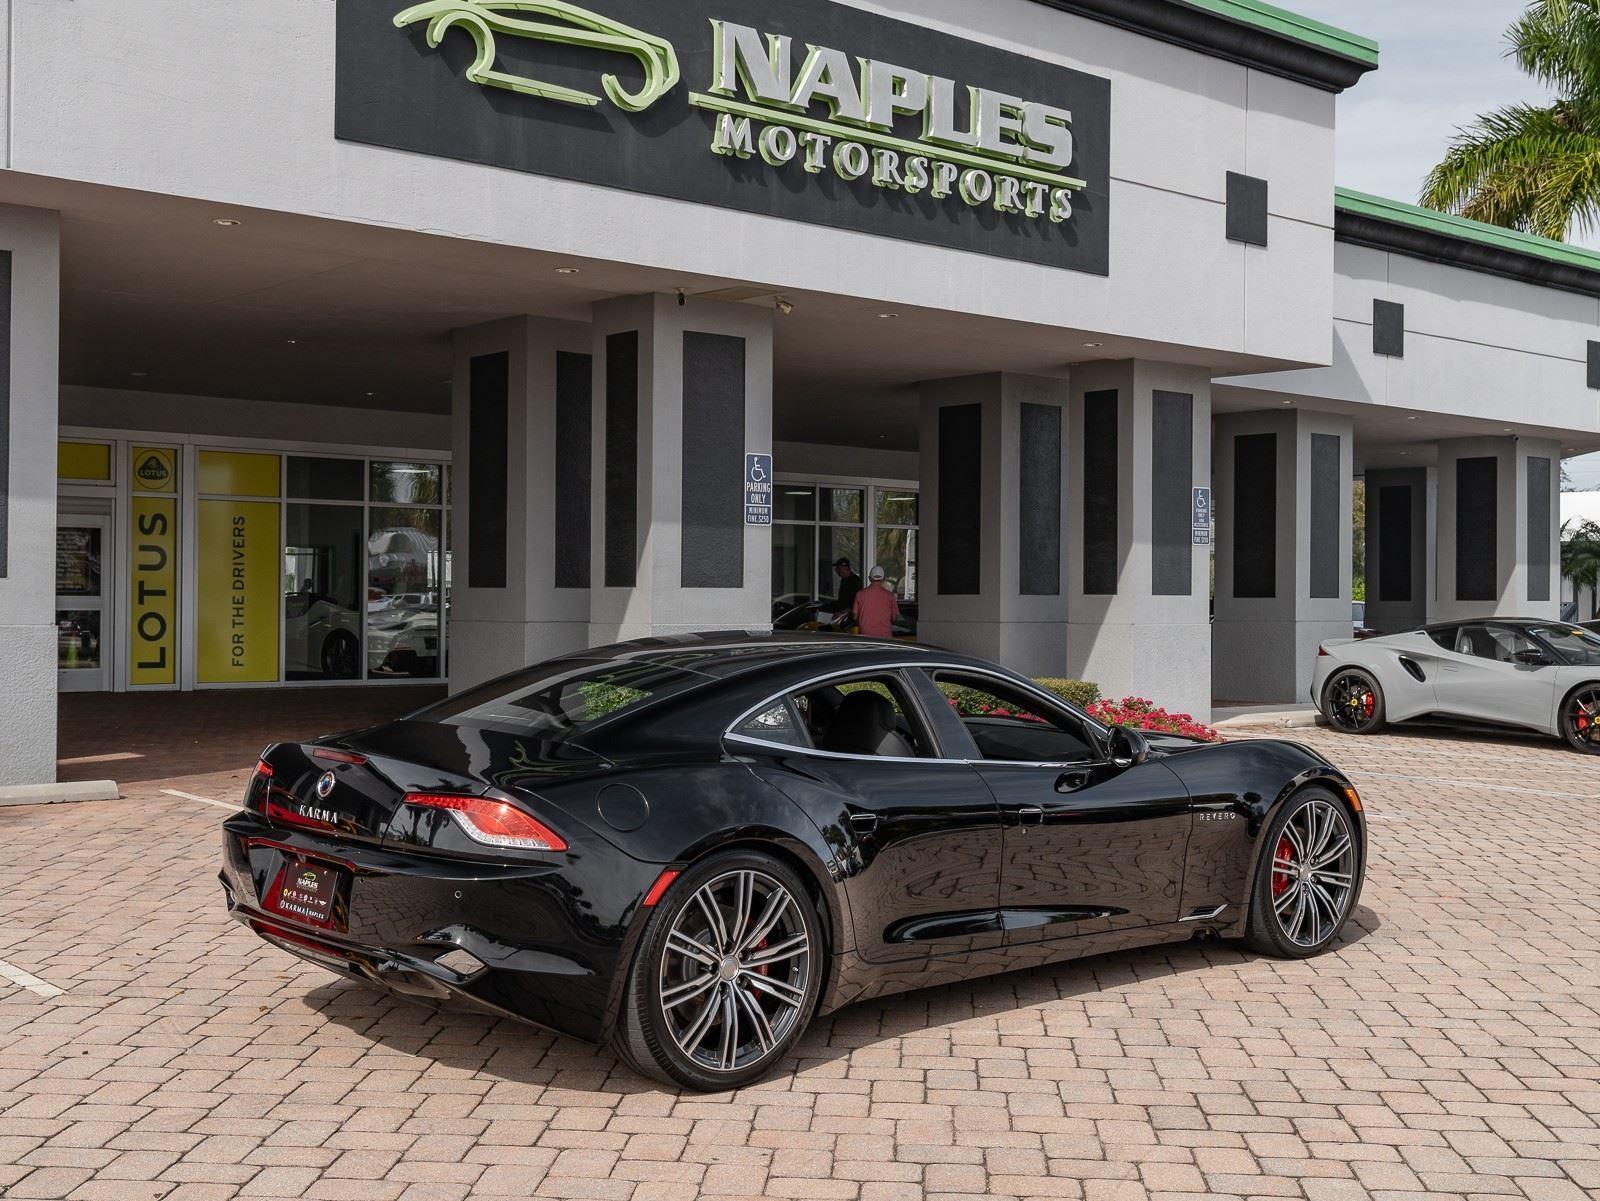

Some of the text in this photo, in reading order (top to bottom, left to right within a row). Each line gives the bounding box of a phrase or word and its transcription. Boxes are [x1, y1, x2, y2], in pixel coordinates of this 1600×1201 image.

[708, 17, 1074, 171] NAPLES
[710, 113, 1073, 223] MOTORSPORTS
[139, 469, 168, 479] LOTUS
[746, 481, 771, 493] PARKING
[750, 493, 767, 504] ONLY
[137, 512, 168, 669] LOTUS
[231, 515, 245, 667] FOR THE DRIVERS
[298, 804, 338, 824] KARMA
[297, 877, 319, 889] NAPLES
